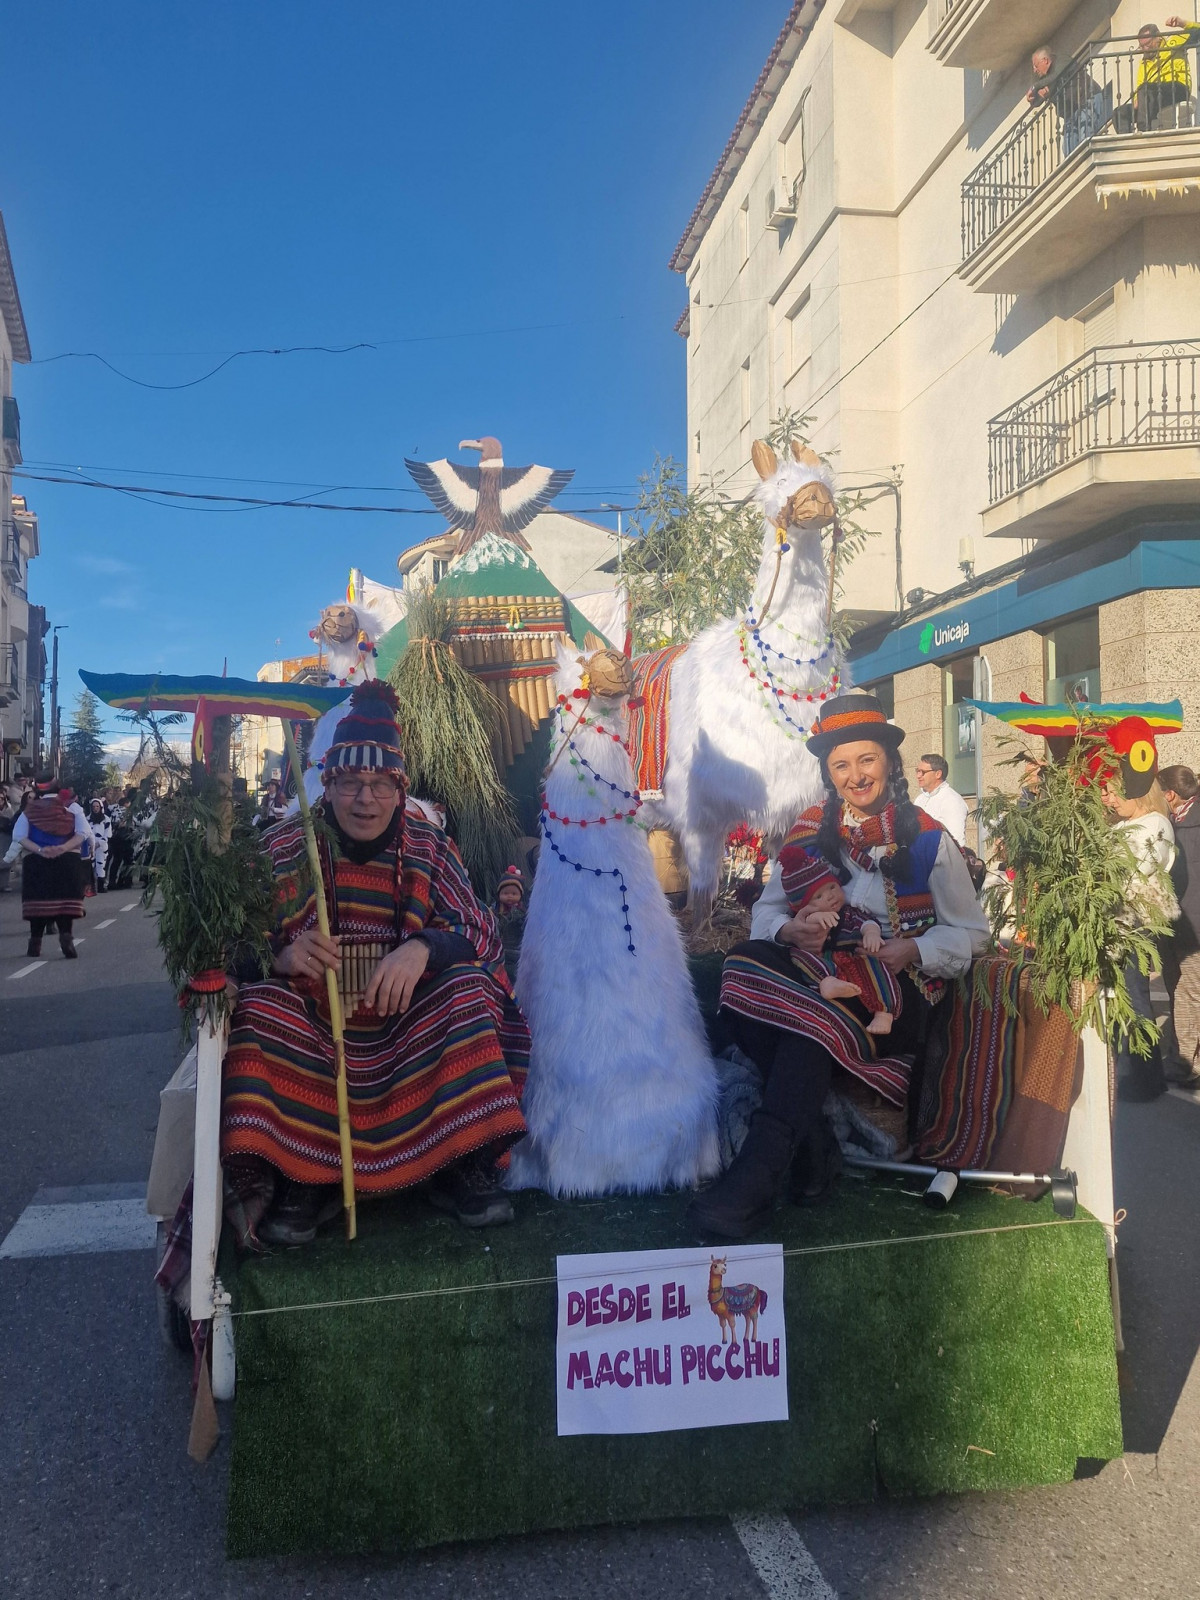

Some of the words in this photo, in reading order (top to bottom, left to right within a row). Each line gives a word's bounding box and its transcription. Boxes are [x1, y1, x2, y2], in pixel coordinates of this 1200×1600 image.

[934, 619, 970, 647] Unicaja
[567, 1283, 652, 1327] DESDE
[662, 1281, 691, 1321] EL
[566, 1344, 672, 1390] MACHU
[680, 1337, 780, 1386] PICCHU
